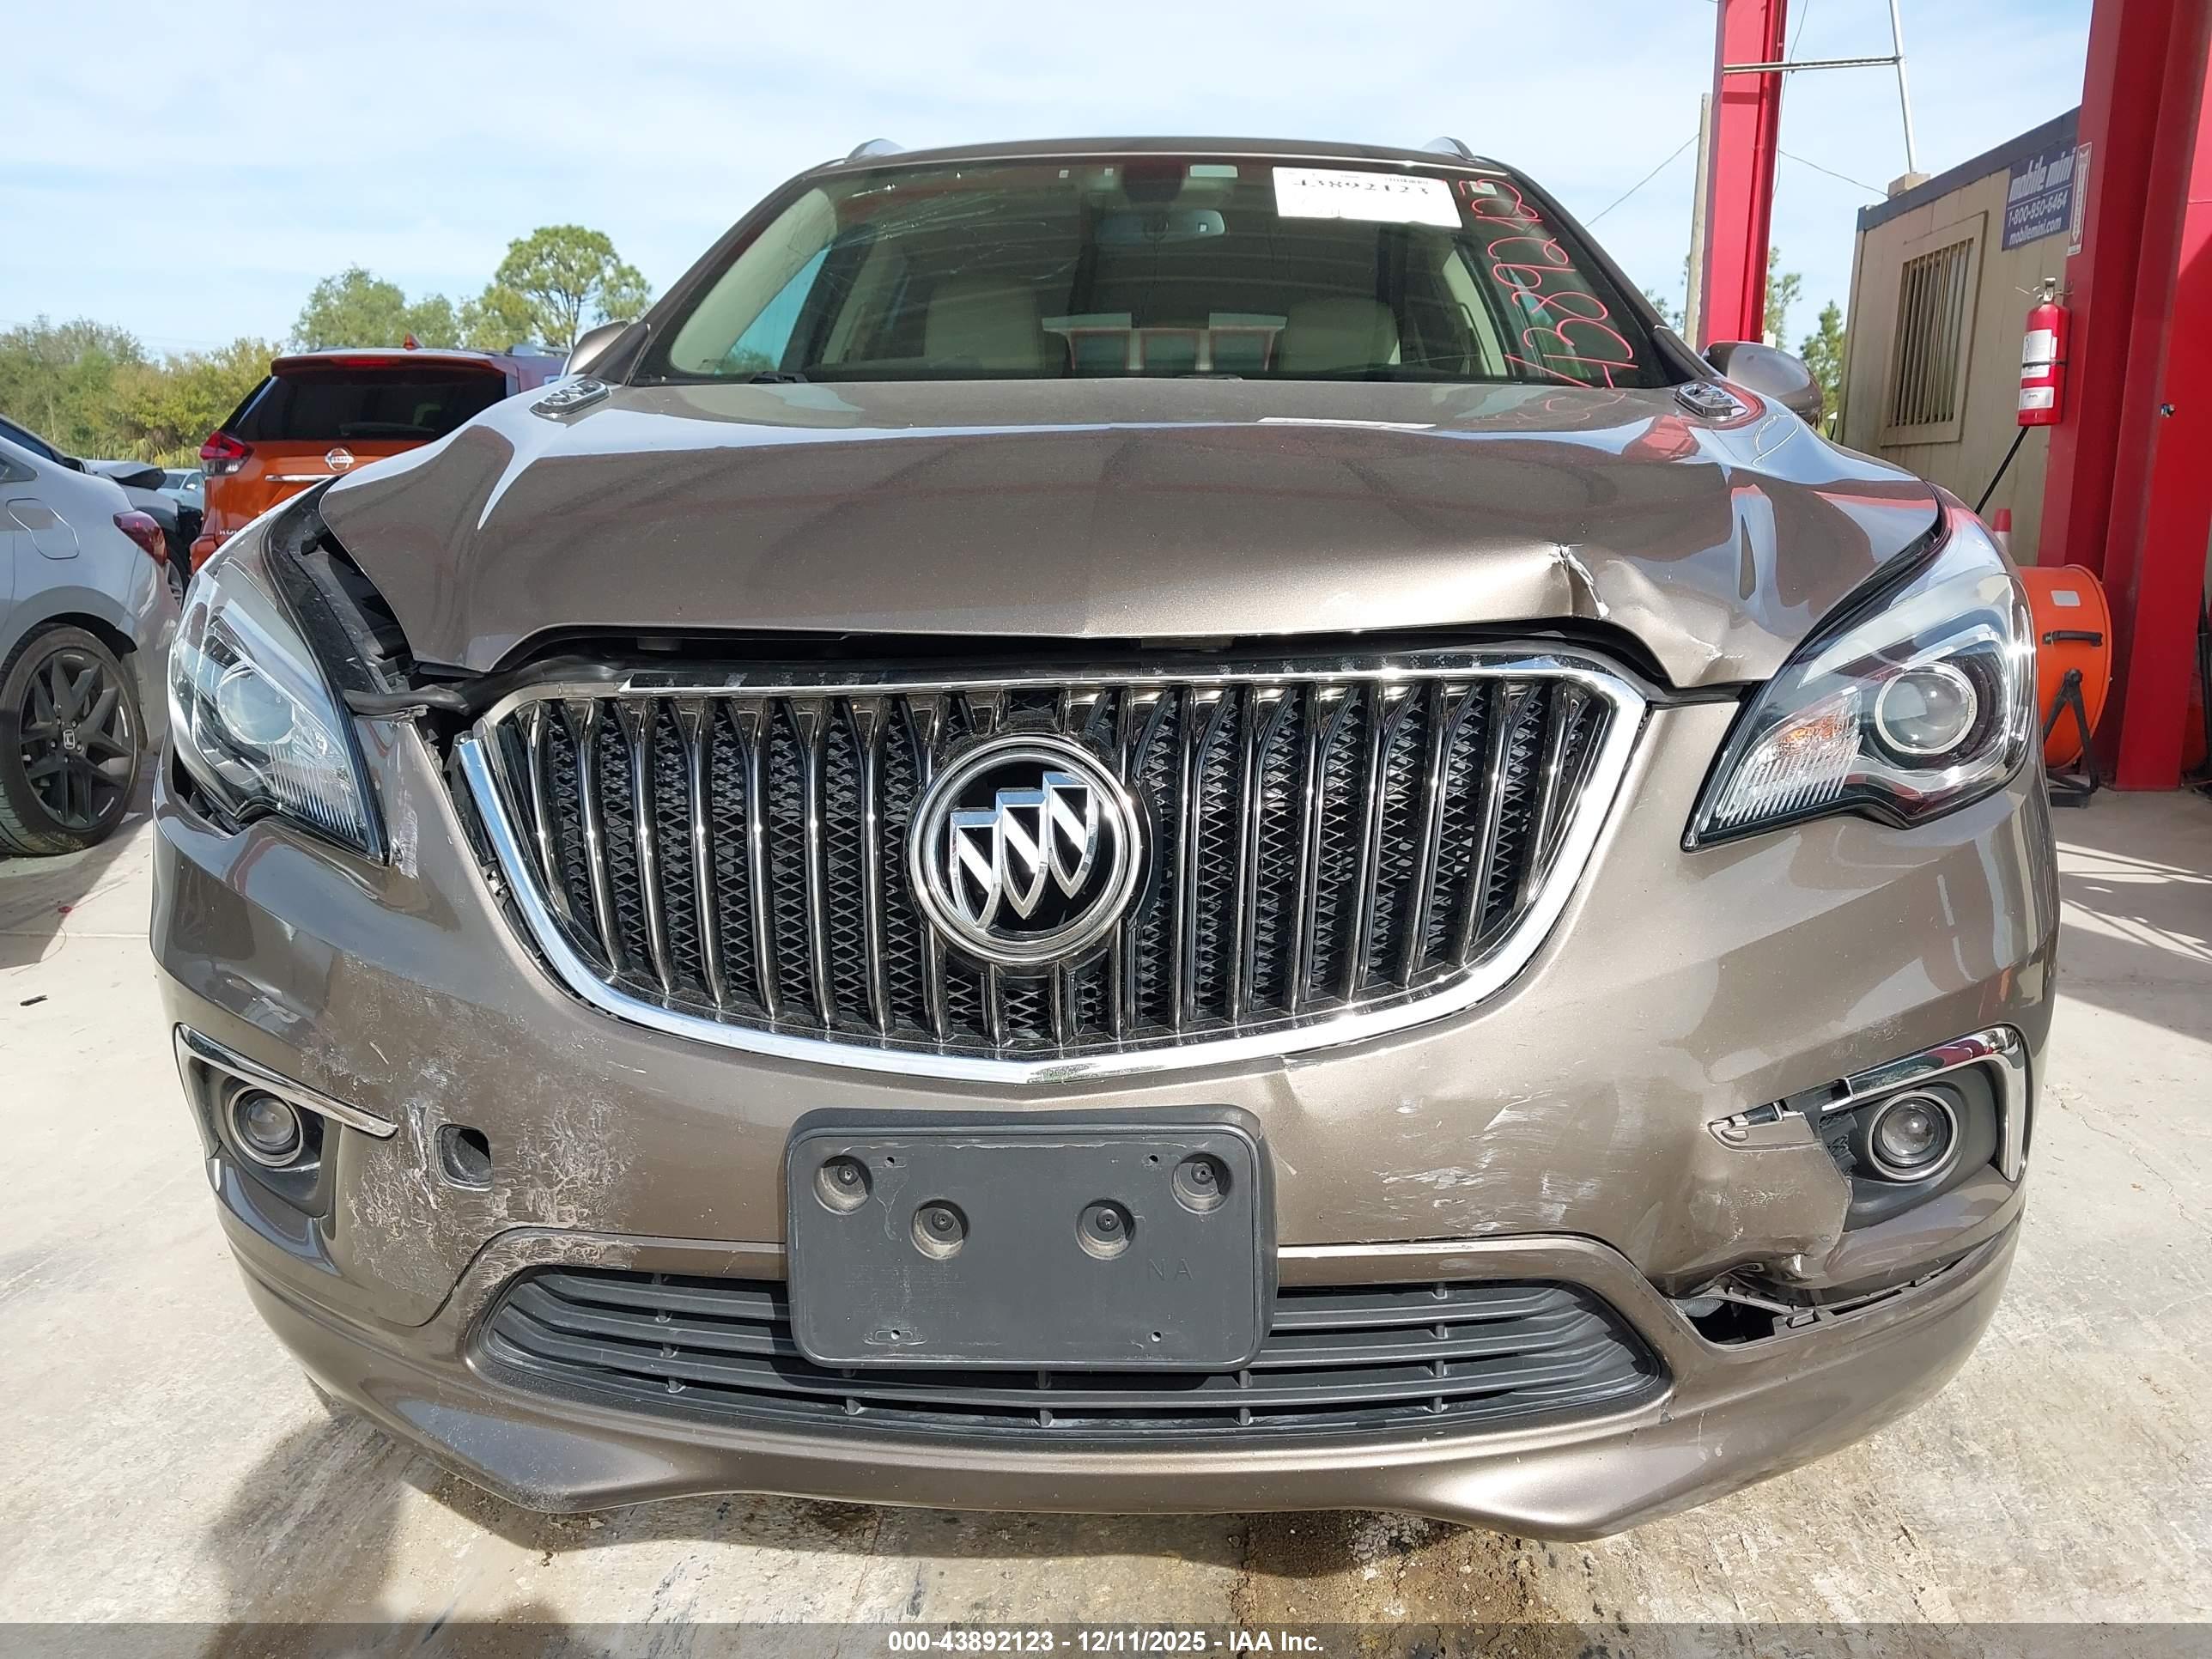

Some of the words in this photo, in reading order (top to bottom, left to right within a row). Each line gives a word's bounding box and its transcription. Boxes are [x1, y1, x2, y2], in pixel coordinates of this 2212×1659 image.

[2008, 155, 2047, 203] mobile
[2045, 146, 2077, 188] mini
[2008, 217, 2062, 246] mobilemini.com
